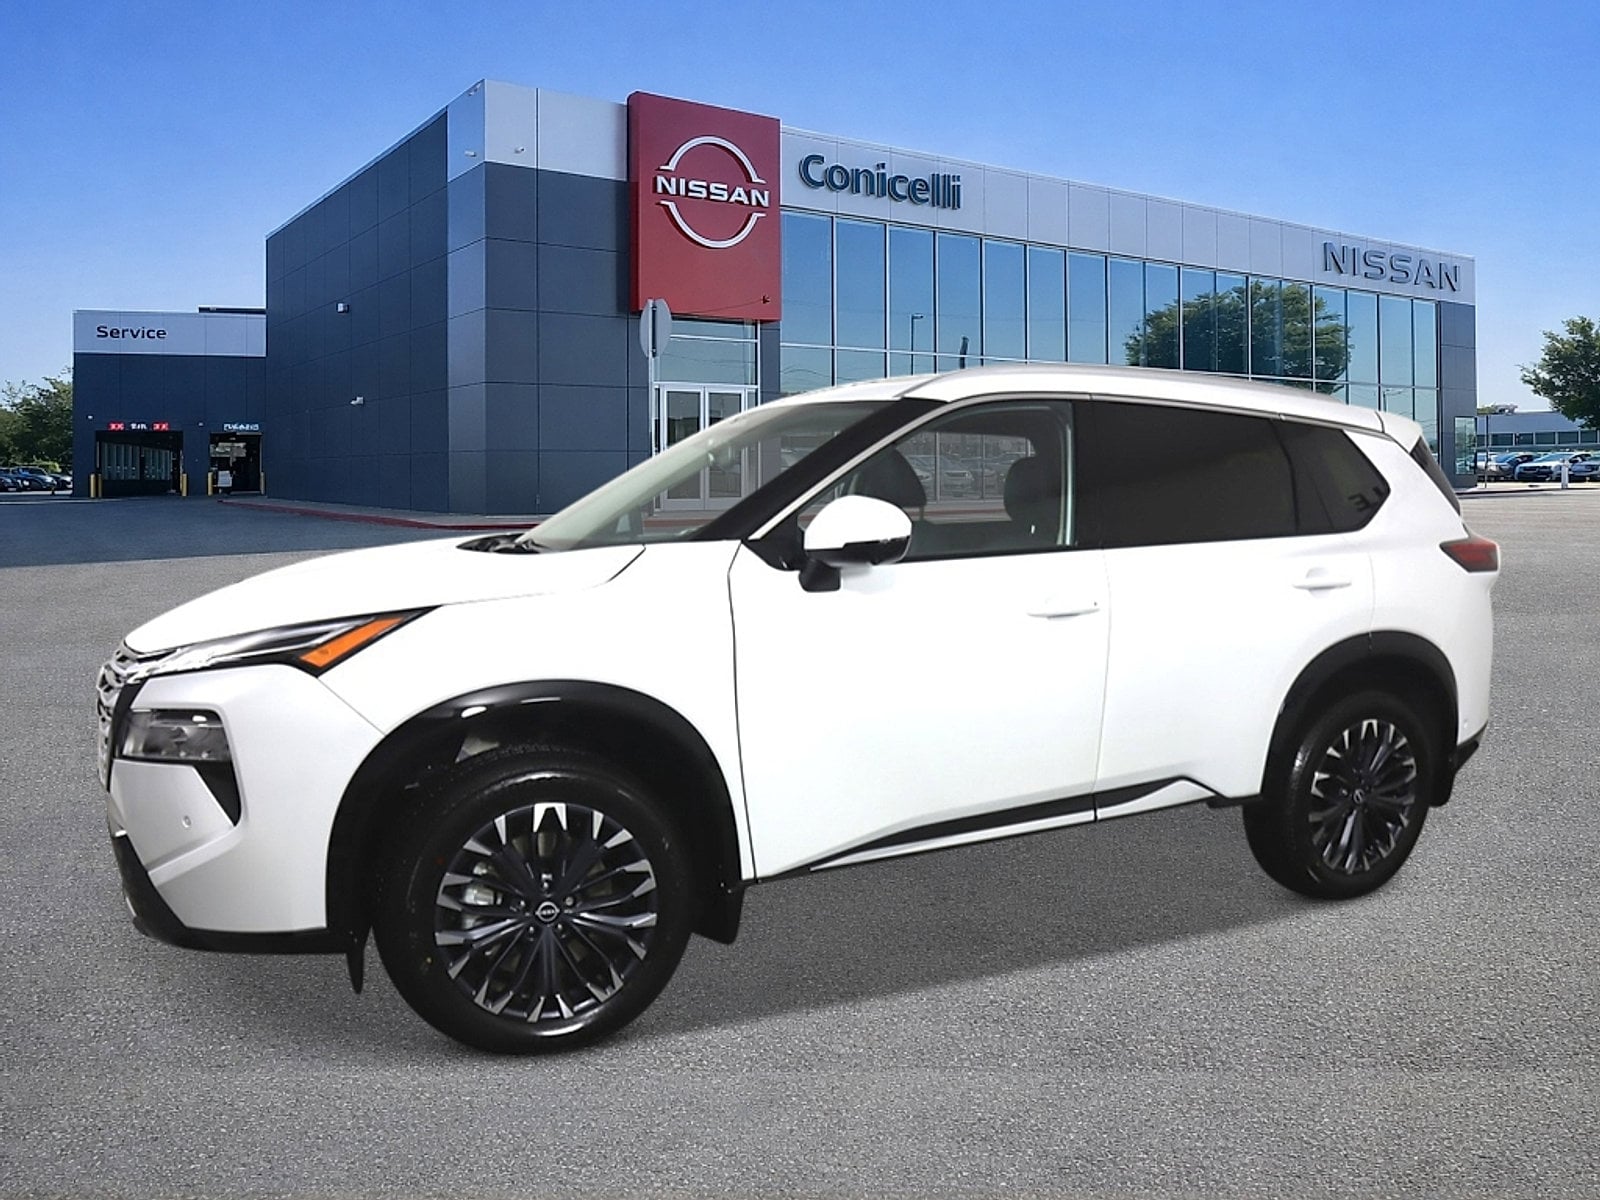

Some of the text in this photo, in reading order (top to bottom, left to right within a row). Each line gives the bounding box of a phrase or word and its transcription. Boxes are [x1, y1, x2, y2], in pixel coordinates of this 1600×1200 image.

[655, 174, 769, 207] NISSAN
[799, 154, 961, 210] Conicelli
[1323, 242, 1461, 292] NISSAN
[96, 325, 167, 339] Service
